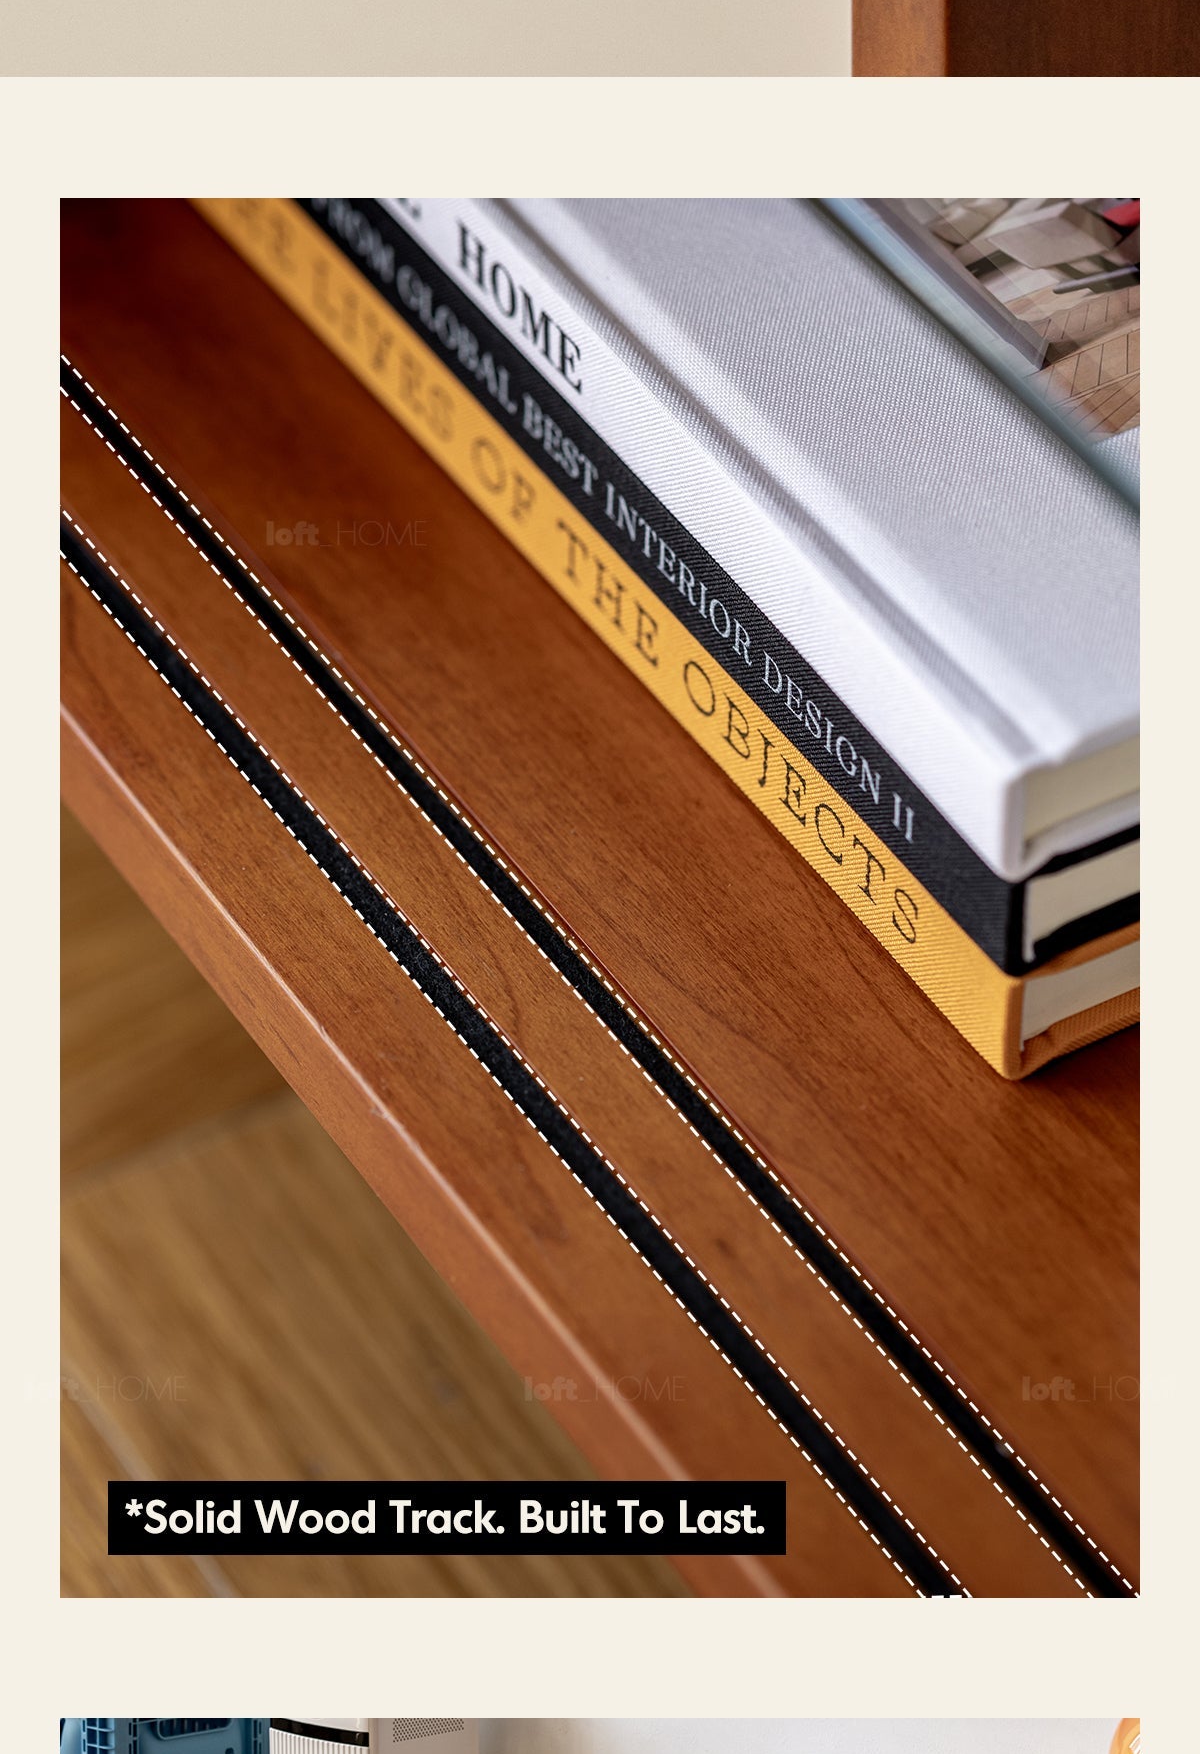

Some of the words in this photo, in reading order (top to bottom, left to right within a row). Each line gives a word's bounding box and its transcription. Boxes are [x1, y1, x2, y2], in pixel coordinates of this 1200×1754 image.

[312, 198, 396, 283] ROM
[397, 265, 518, 414] GLOBAL
[523, 390, 599, 496] BEST
[605, 481, 752, 666] INTERIOR
[762, 652, 881, 805] DESIGN
[891, 791, 914, 844] II
[457, 218, 582, 395] HOME
[471, 437, 538, 524] OF
[557, 521, 658, 668] THE
[682, 660, 919, 945] OBJECTS
